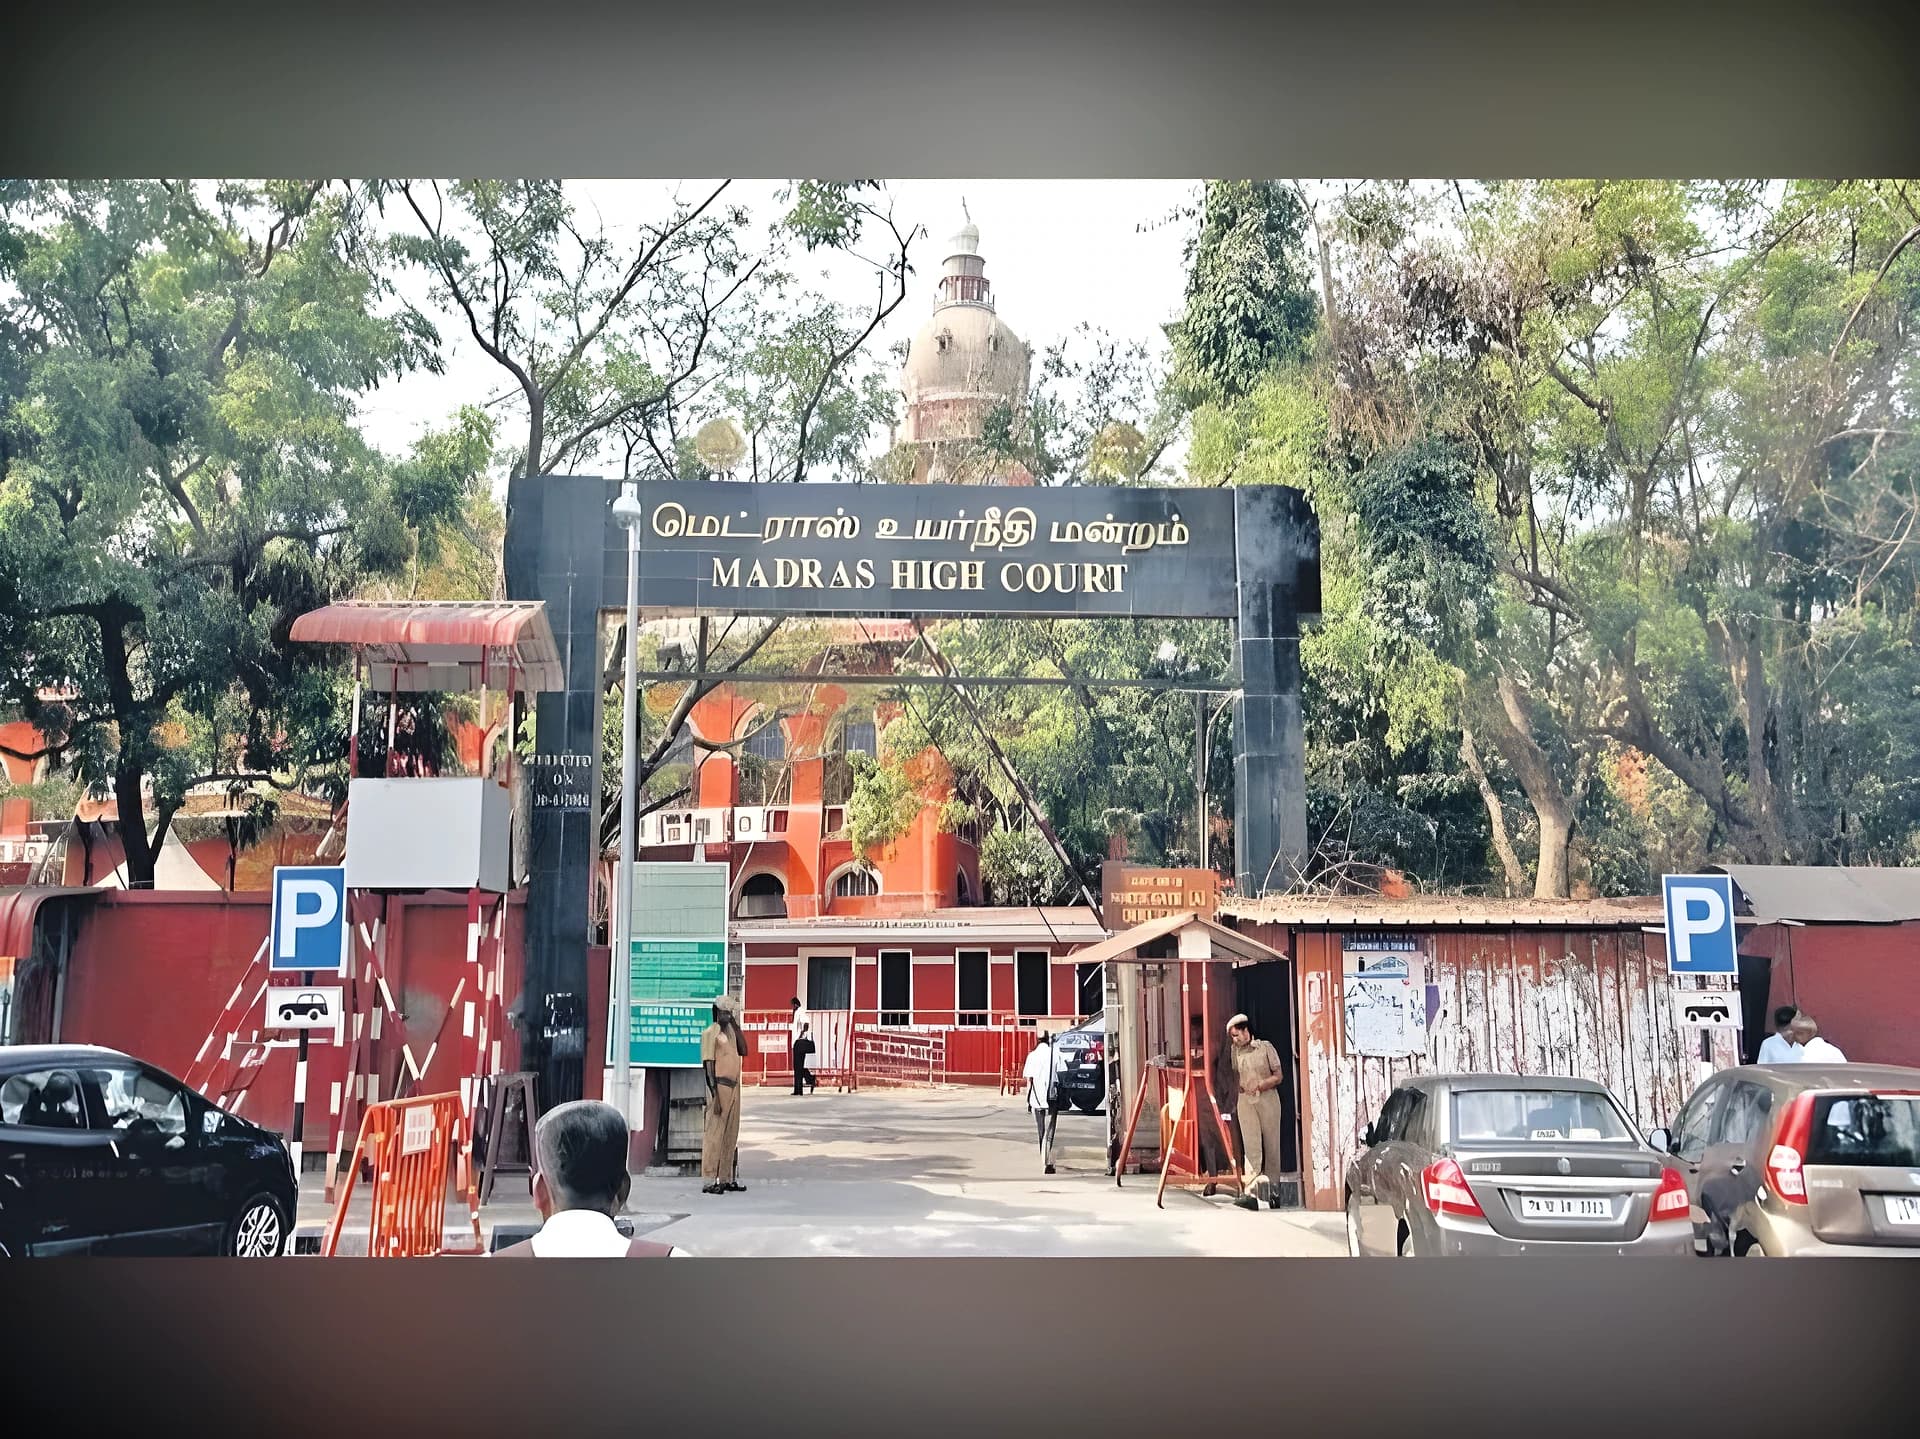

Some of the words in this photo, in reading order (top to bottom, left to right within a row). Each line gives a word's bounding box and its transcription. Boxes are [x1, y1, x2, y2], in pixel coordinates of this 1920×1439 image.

[651, 501, 861, 546] மெட்ராஸ்
[874, 505, 1038, 553] உயர்நீதி
[1049, 512, 1191, 555] மன்றம்
[711, 556, 875, 590] MADRAS
[890, 558, 986, 592] HIGH
[1000, 560, 1129, 594] COURT
[279, 879, 339, 958] P
[1670, 886, 1726, 963] P
